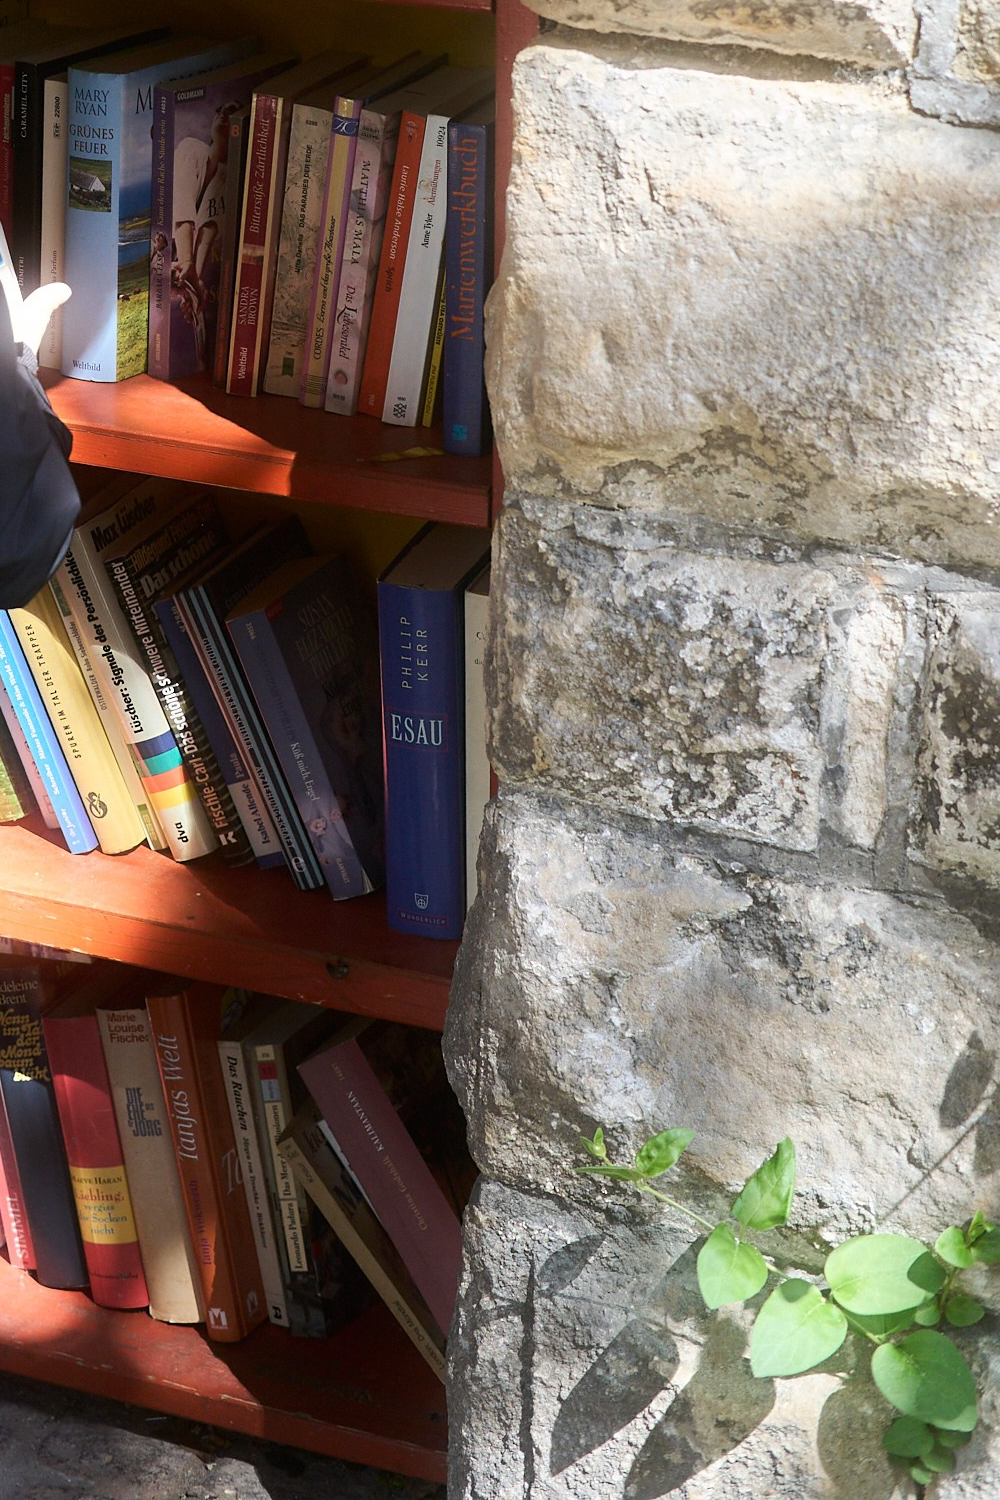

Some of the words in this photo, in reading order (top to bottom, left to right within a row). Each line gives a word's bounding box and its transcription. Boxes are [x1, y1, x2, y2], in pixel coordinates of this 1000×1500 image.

[21, 72, 29, 92] CITY
[74, 88, 110, 102] MARY
[177, 89, 205, 100] GOLDMANN
[75, 101, 108, 117] RYAN
[69, 125, 114, 141] GRÜNES
[73, 140, 109, 155] FEUER
[436, 126, 447, 148] 10924
[239, 285, 250, 326] SANDRA
[247, 287, 259, 326] BROWN
[313, 328, 325, 360] CORDES
[71, 360, 102, 371] Weltbild
[237, 347, 248, 380] Weltbild
[24, 624, 46, 667] TRAPPER
[401, 616, 413, 689] PHILIP
[416, 627, 428, 682] KERR
[101, 645, 125, 687] Signale
[51, 690, 62, 707] TAL
[120, 688, 144, 734] Lüscher:
[61, 730, 82, 759] SPUREN
[391, 714, 443, 746] ESAU
[175, 822, 189, 844] dva
[107, 1013, 136, 1022] Marie
[108, 1024, 144, 1032] Louise
[110, 1034, 148, 1043] Fischer
[158, 1035, 186, 1084] Welt
[226, 1056, 238, 1077] Das
[232, 1078, 248, 1130] Rauchen
[170, 1089, 199, 1162] Tanjas
